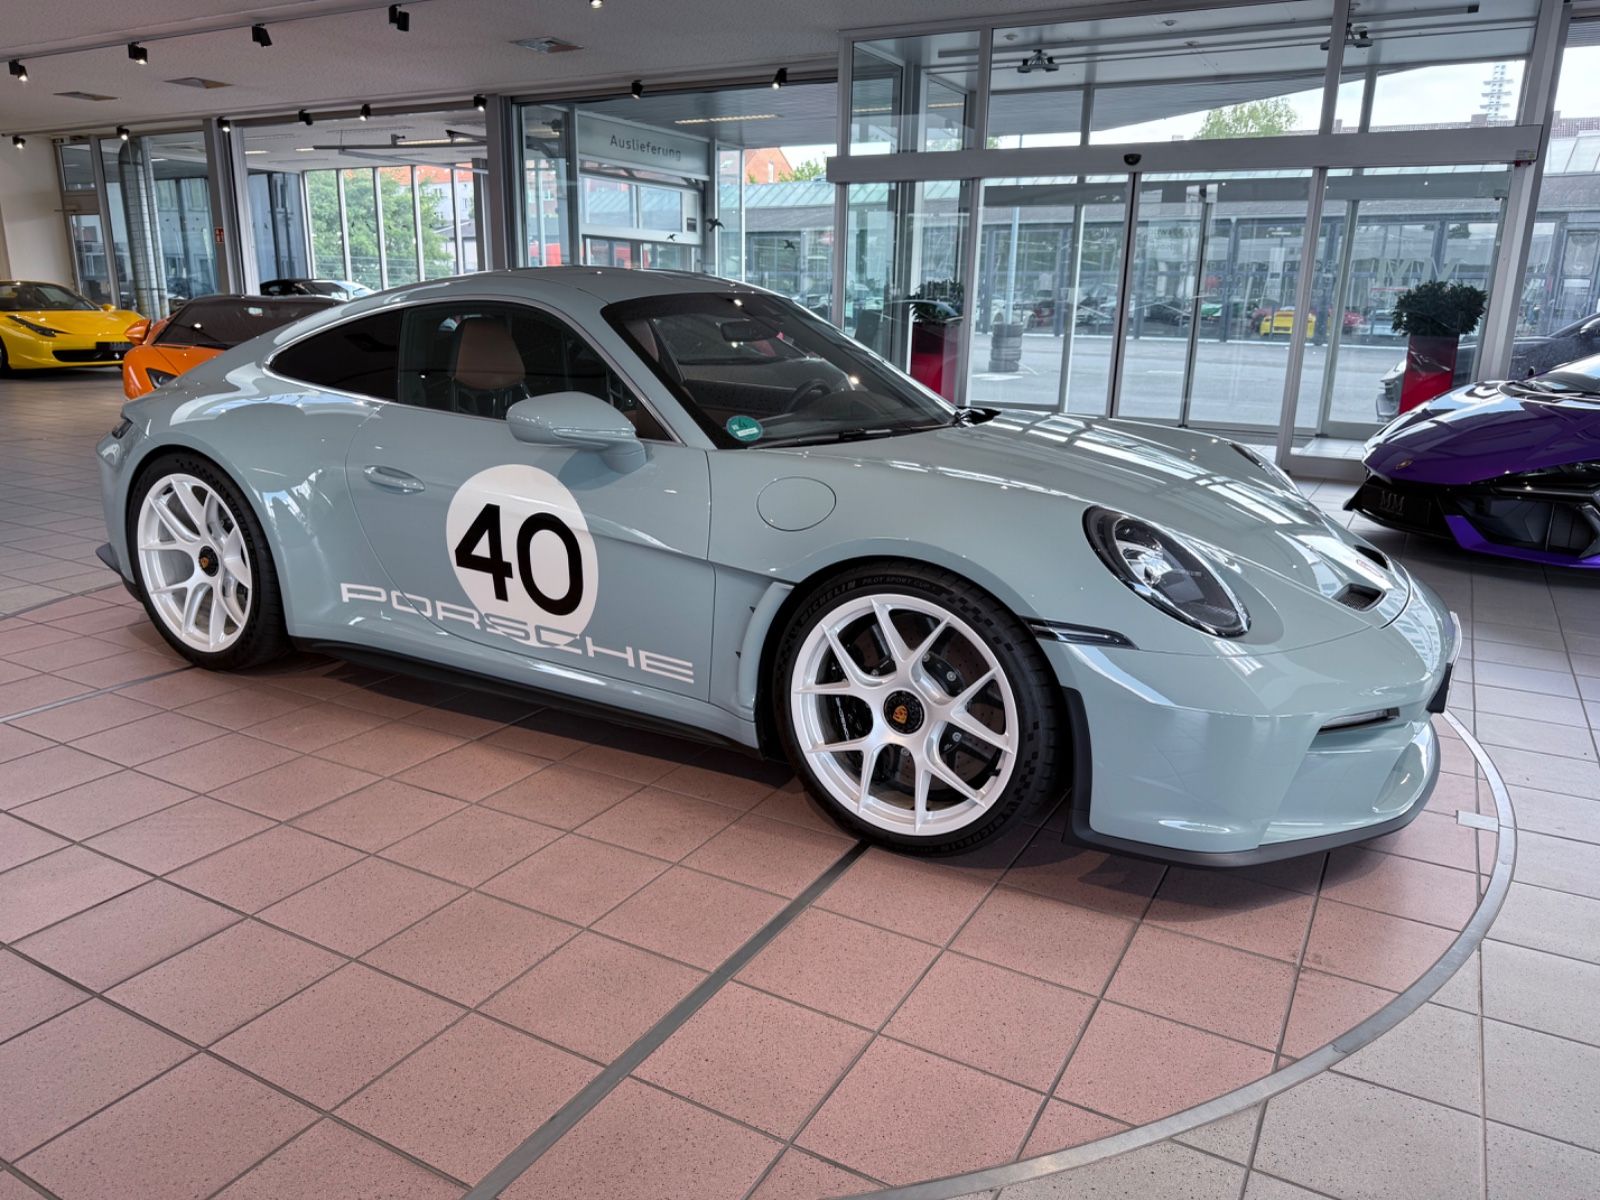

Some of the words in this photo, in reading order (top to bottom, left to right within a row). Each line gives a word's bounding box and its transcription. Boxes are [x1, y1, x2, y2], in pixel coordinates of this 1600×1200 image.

[610, 135, 681, 161] Auslieferung
[455, 503, 584, 616] 40
[340, 582, 694, 684] PORSCHE
[800, 580, 856, 624] MICHELIN
